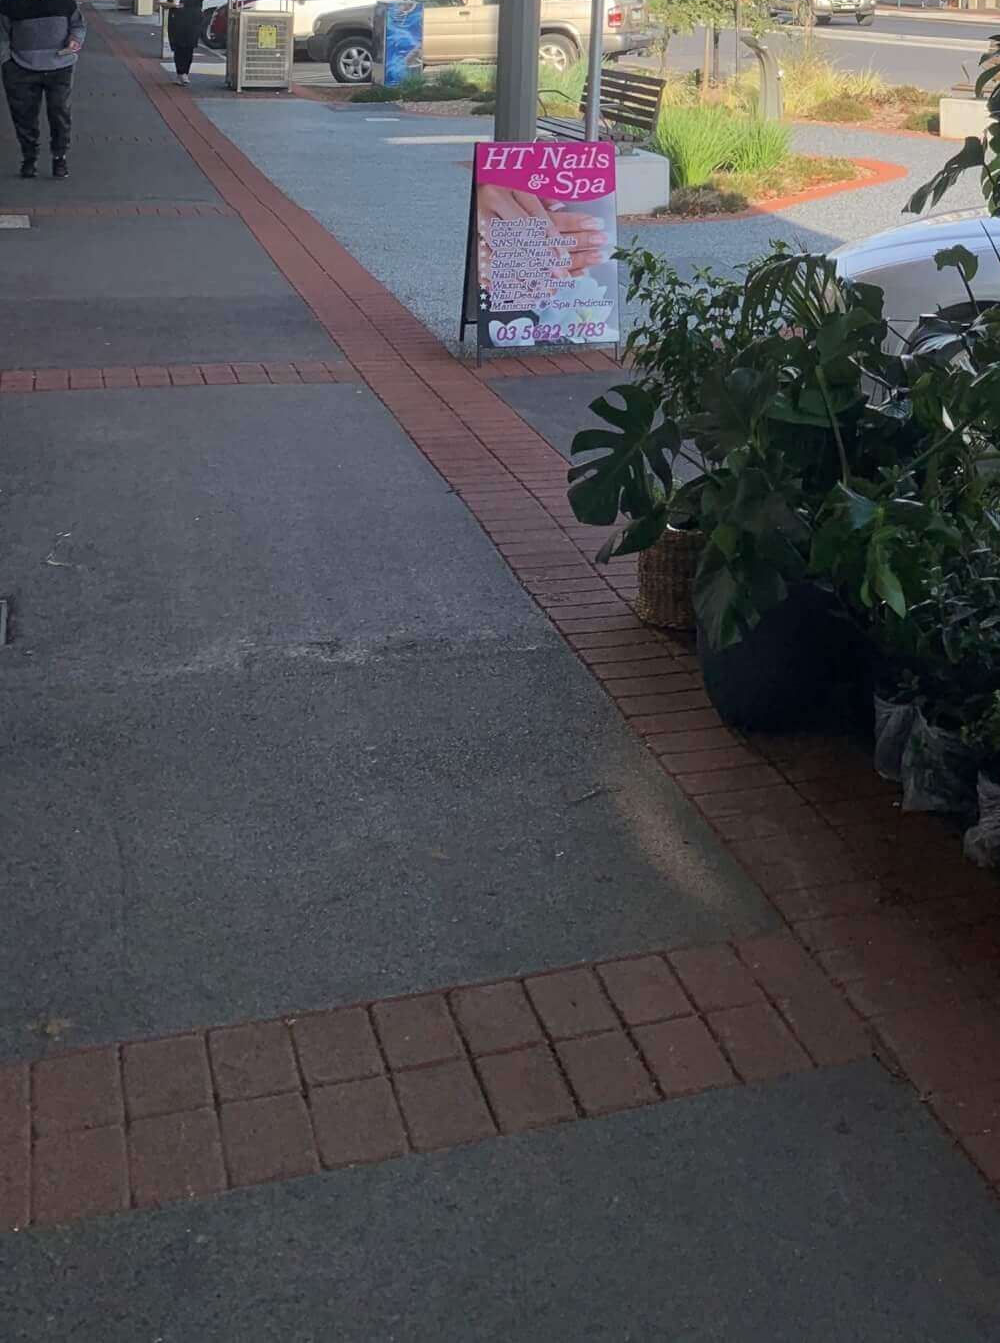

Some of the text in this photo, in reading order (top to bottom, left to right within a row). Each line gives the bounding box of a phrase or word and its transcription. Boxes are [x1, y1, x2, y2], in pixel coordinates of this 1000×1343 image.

[482, 146, 609, 171] HT Nails
[527, 171, 606, 199] & Spa
[491, 218, 547, 228] French Tips
[491, 229, 545, 238] Colour Tips
[491, 239, 513, 248] SNS
[491, 259, 525, 268] Shellac
[548, 258, 571, 266] Nails
[544, 279, 575, 288] Tinting
[492, 302, 536, 311] Manicure
[553, 301, 570, 309] Spa
[574, 299, 613, 308] Pedicure
[497, 326, 517, 340] 03
[567, 322, 605, 337] 3783
